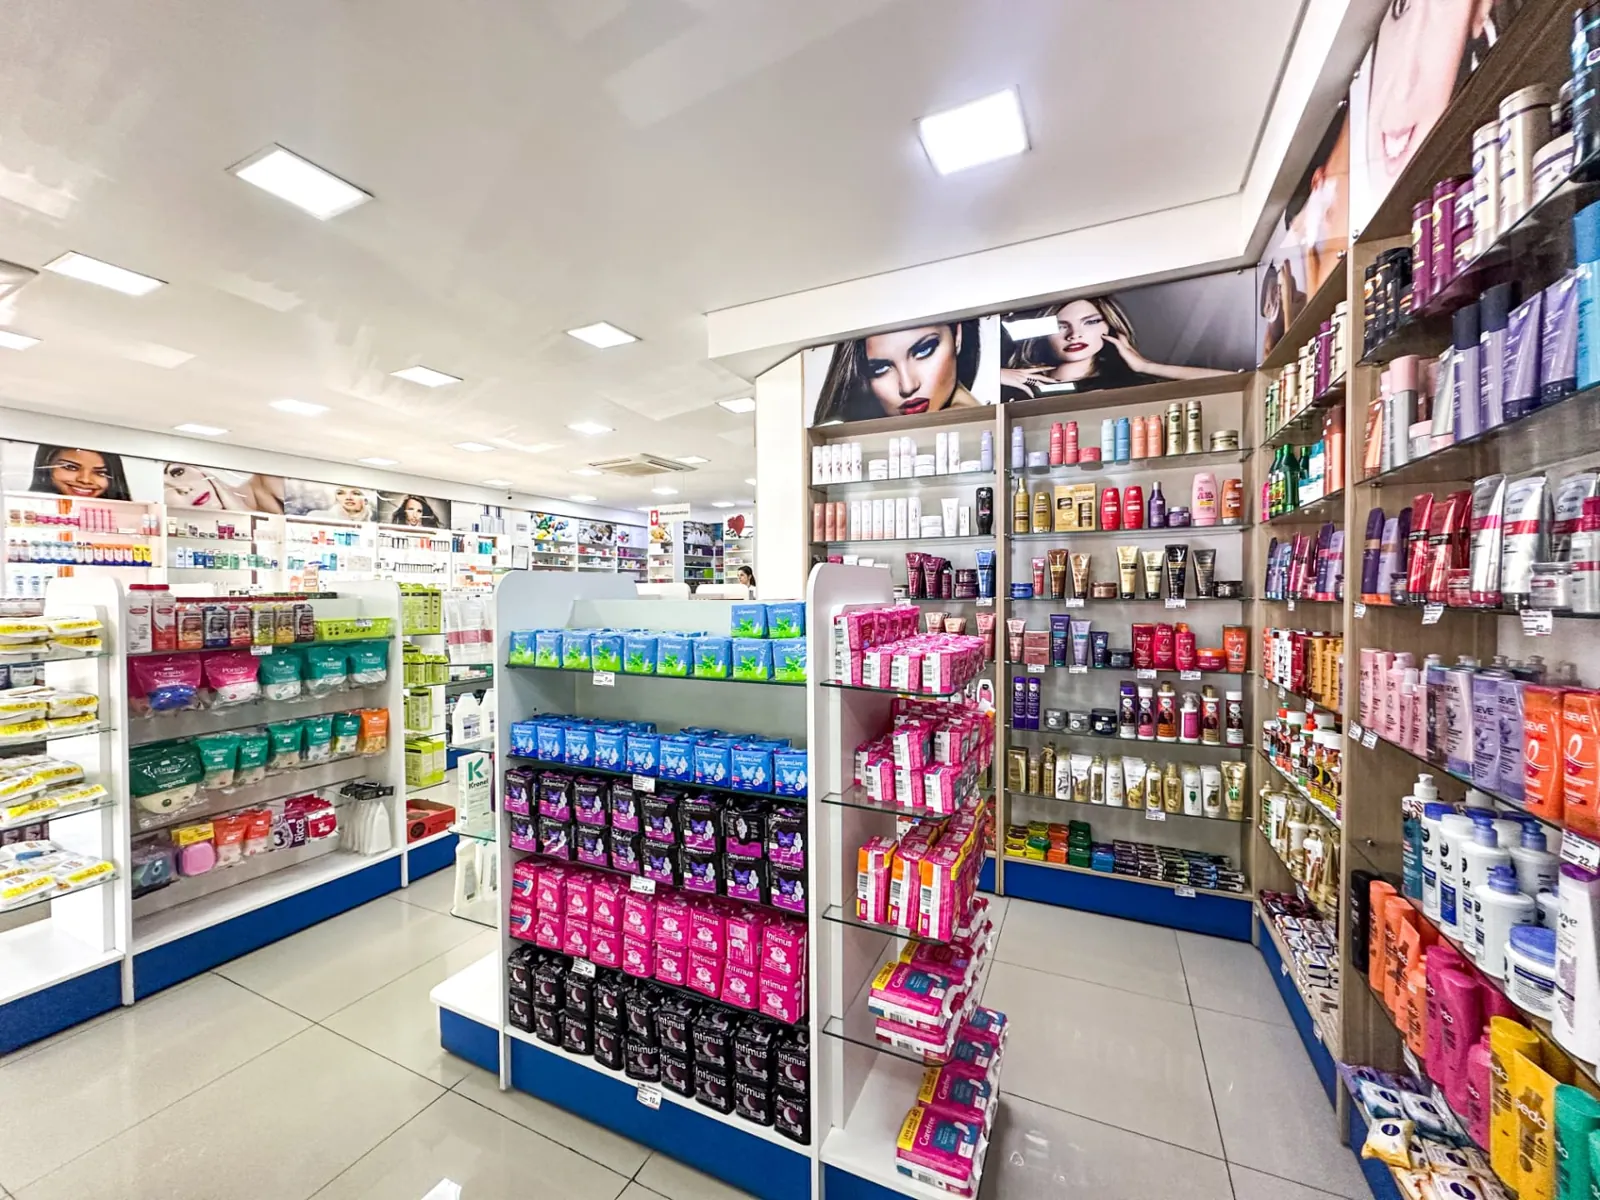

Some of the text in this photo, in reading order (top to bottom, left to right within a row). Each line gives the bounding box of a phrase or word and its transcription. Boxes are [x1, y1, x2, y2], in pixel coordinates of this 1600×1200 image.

[295, 818, 305, 843] Ricca
[657, 904, 684, 917] Intimus
[692, 913, 719, 927] Intimus
[766, 931, 793, 948] Intimus
[692, 952, 717, 968] Intimus
[726, 962, 754, 978] Intimus
[760, 977, 788, 993] Intimus
[692, 1030, 725, 1047] Intimus
[626, 1042, 660, 1056] Intimus
[734, 1040, 768, 1060] Intimus
[777, 1051, 807, 1068] Intimus
[695, 1068, 727, 1088] Intimus
[1514, 1097, 1549, 1131] seda
[918, 1115, 936, 1147] Carefree
